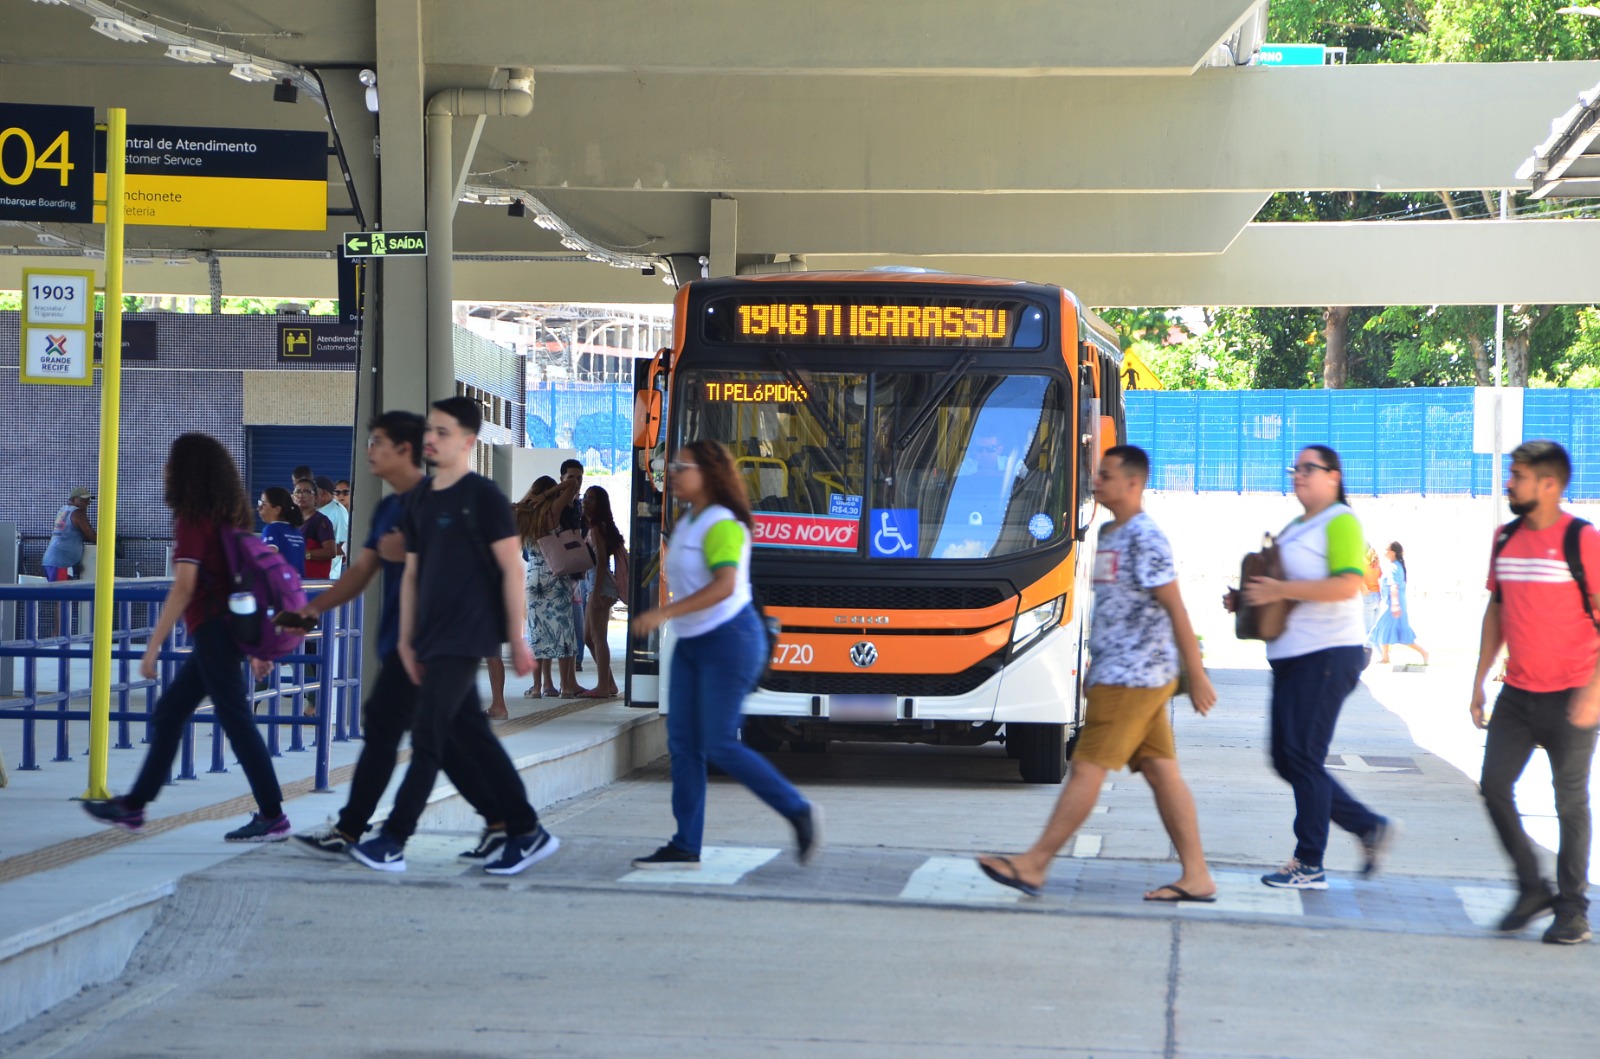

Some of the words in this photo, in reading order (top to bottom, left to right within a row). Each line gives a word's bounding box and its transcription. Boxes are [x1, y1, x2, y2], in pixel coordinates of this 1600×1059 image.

[126, 138, 154, 149] ntral
[156, 138, 173, 150] de
[175, 139, 257, 153] Atendimento
[0, 127, 75, 187] 04
[124, 154, 161, 165] stomer
[163, 154, 203, 166] Service
[0, 196, 37, 208] mbarque
[38, 197, 77, 211] Boarding
[124, 190, 182, 203] nchonete
[389, 235, 424, 249] SAÍDA
[32, 285, 75, 301] 1903
[738, 304, 808, 335] 1946
[812, 304, 842, 336] TI
[849, 305, 1007, 338] IGARASSU
[317, 334, 358, 345] Atendiment
[316, 343, 345, 352] Customer
[40, 356, 71, 365] GRANDE
[41, 363, 70, 372] RECIFE
[706, 383, 720, 401] TI
[752, 521, 792, 540] BUS
[794, 524, 853, 543] NOVO
[772, 643, 814, 665] .720
